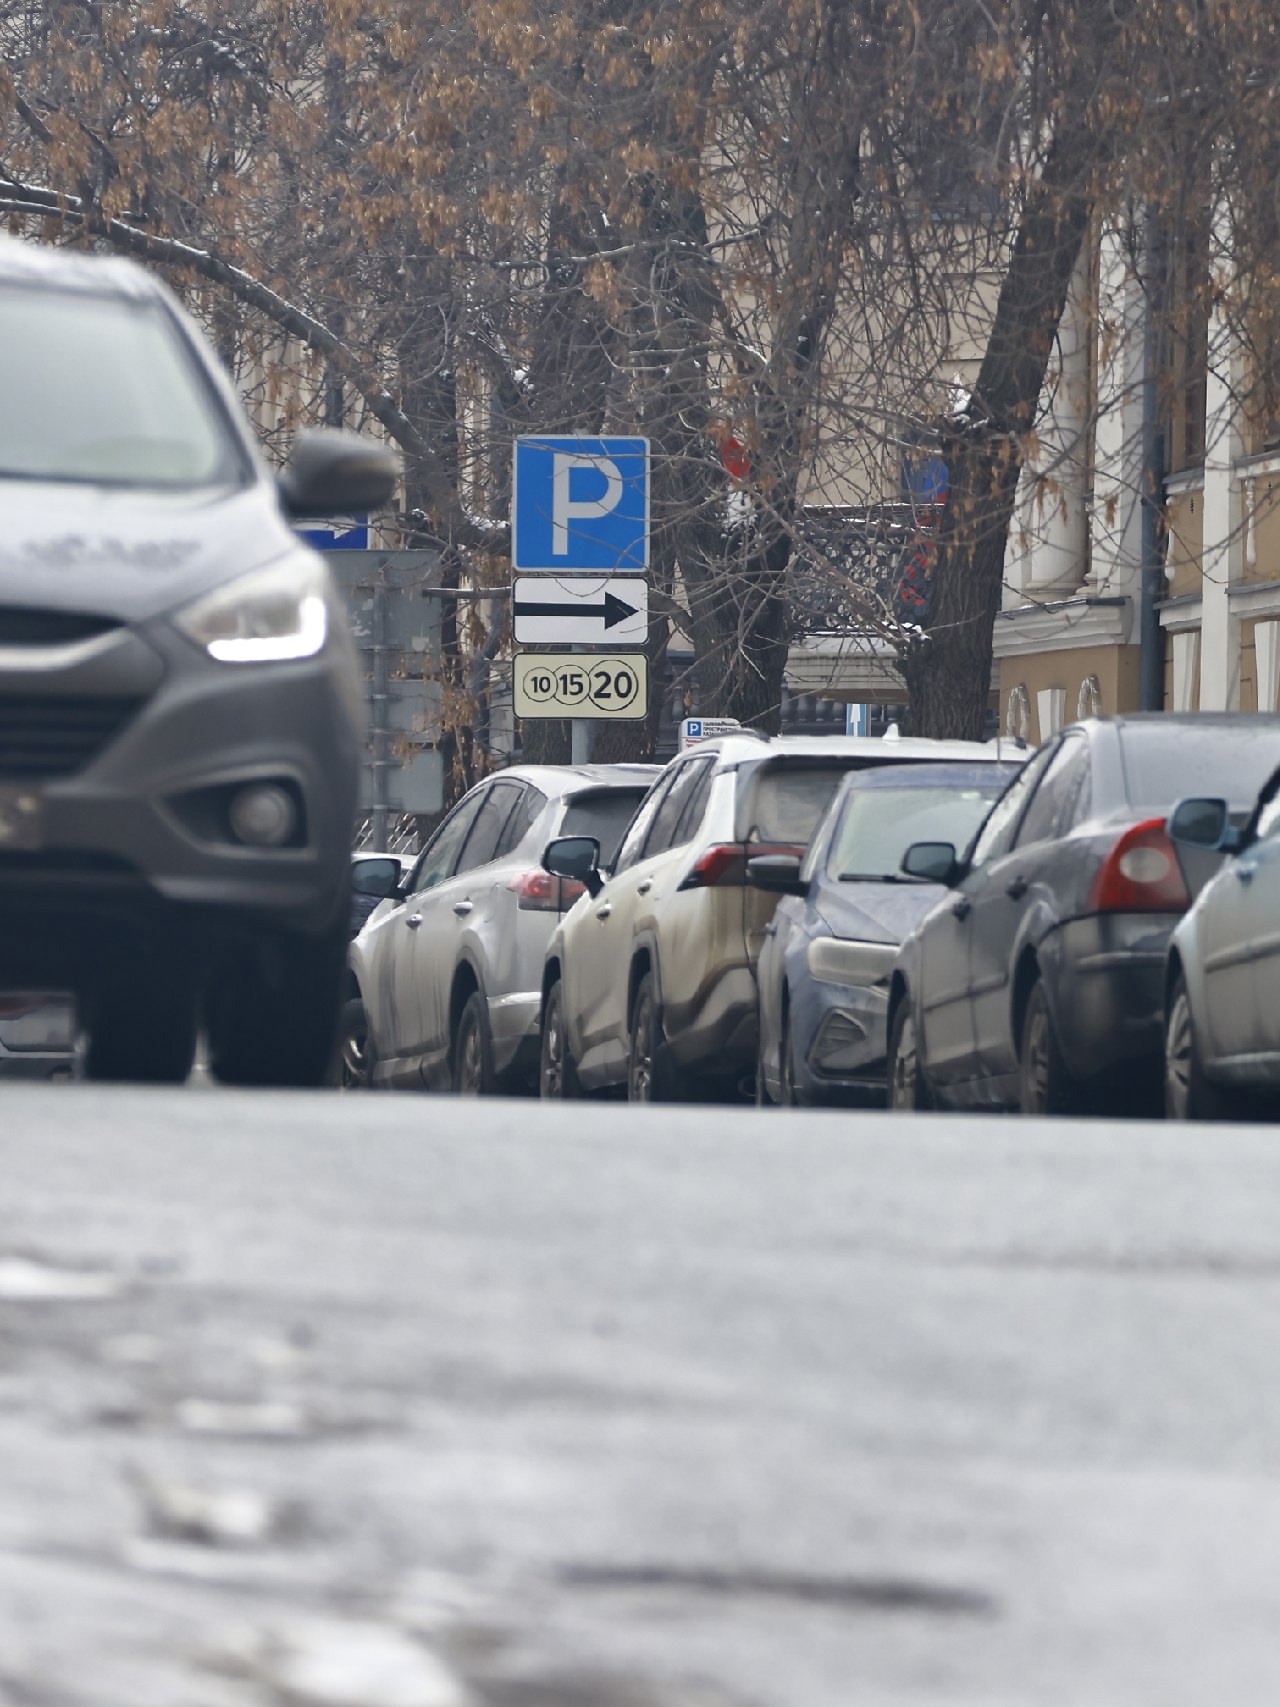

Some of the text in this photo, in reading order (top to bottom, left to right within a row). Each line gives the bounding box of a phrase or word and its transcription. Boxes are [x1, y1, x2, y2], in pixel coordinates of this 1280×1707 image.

[552, 453, 623, 555] P
[530, 671, 633, 699] 10 15 20
[690, 723, 699, 734] P
